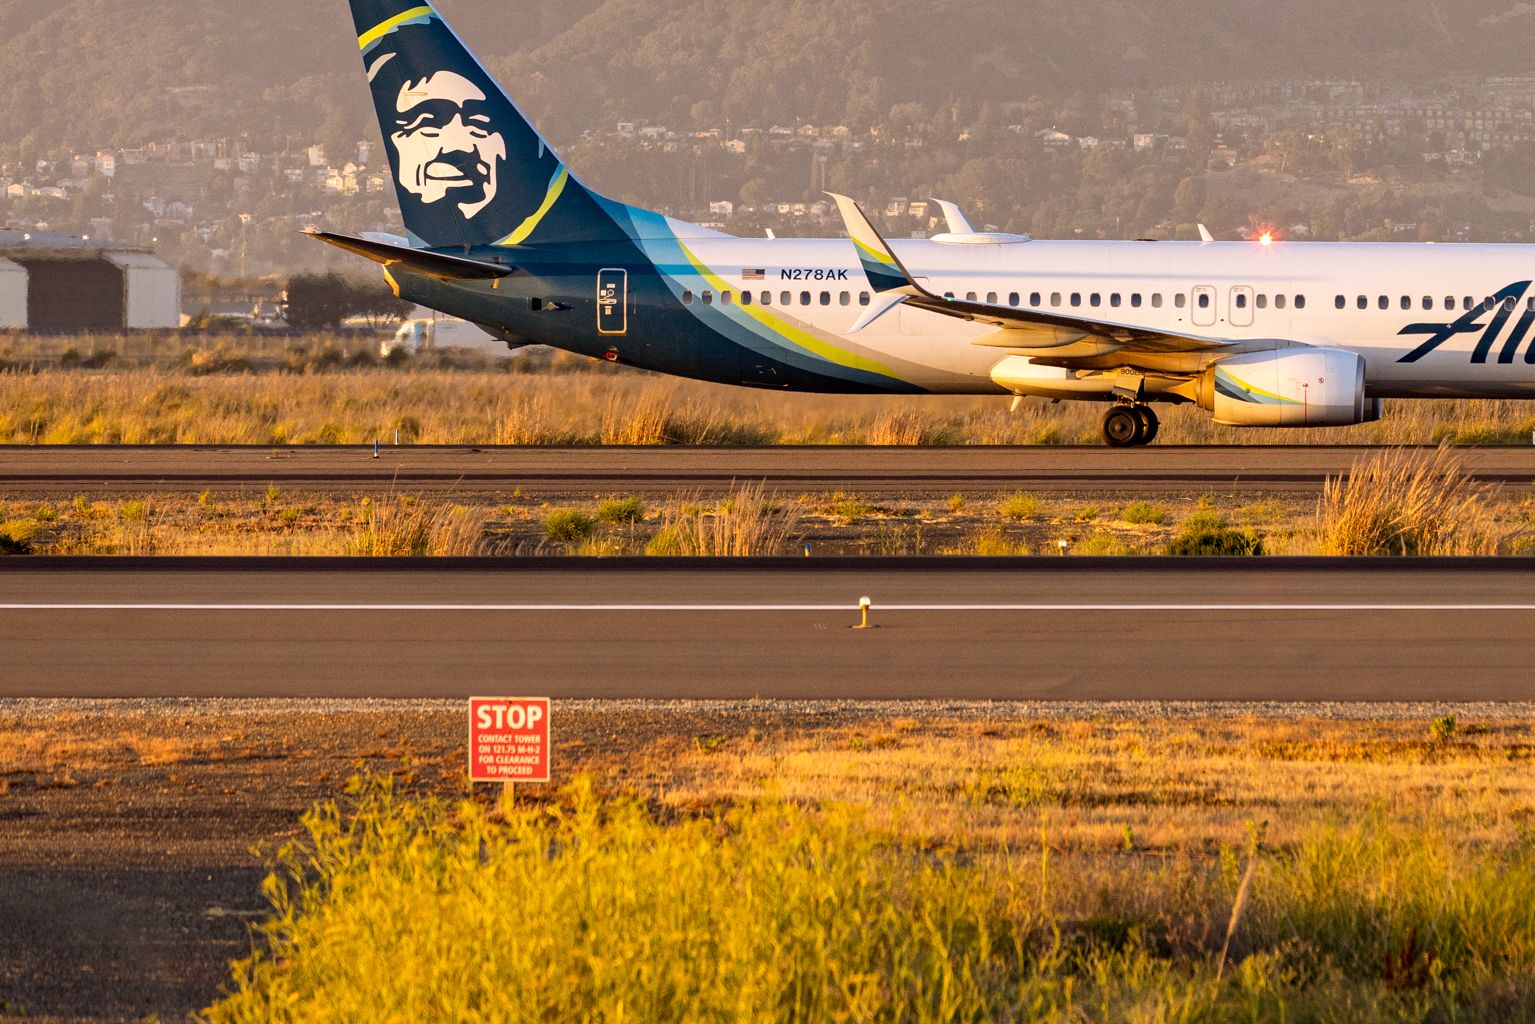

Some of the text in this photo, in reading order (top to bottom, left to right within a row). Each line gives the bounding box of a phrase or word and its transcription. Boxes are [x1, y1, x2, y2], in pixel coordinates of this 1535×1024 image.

[781, 269, 848, 281] N278AK
[477, 705, 543, 730] STOP
[478, 734, 541, 744] CONTACT TOWER
[478, 745, 491, 754] ON
[493, 745, 516, 754] 121.75
[478, 755, 540, 765] FOR CLEARANCE
[486, 766, 533, 775] TO PROCEED
